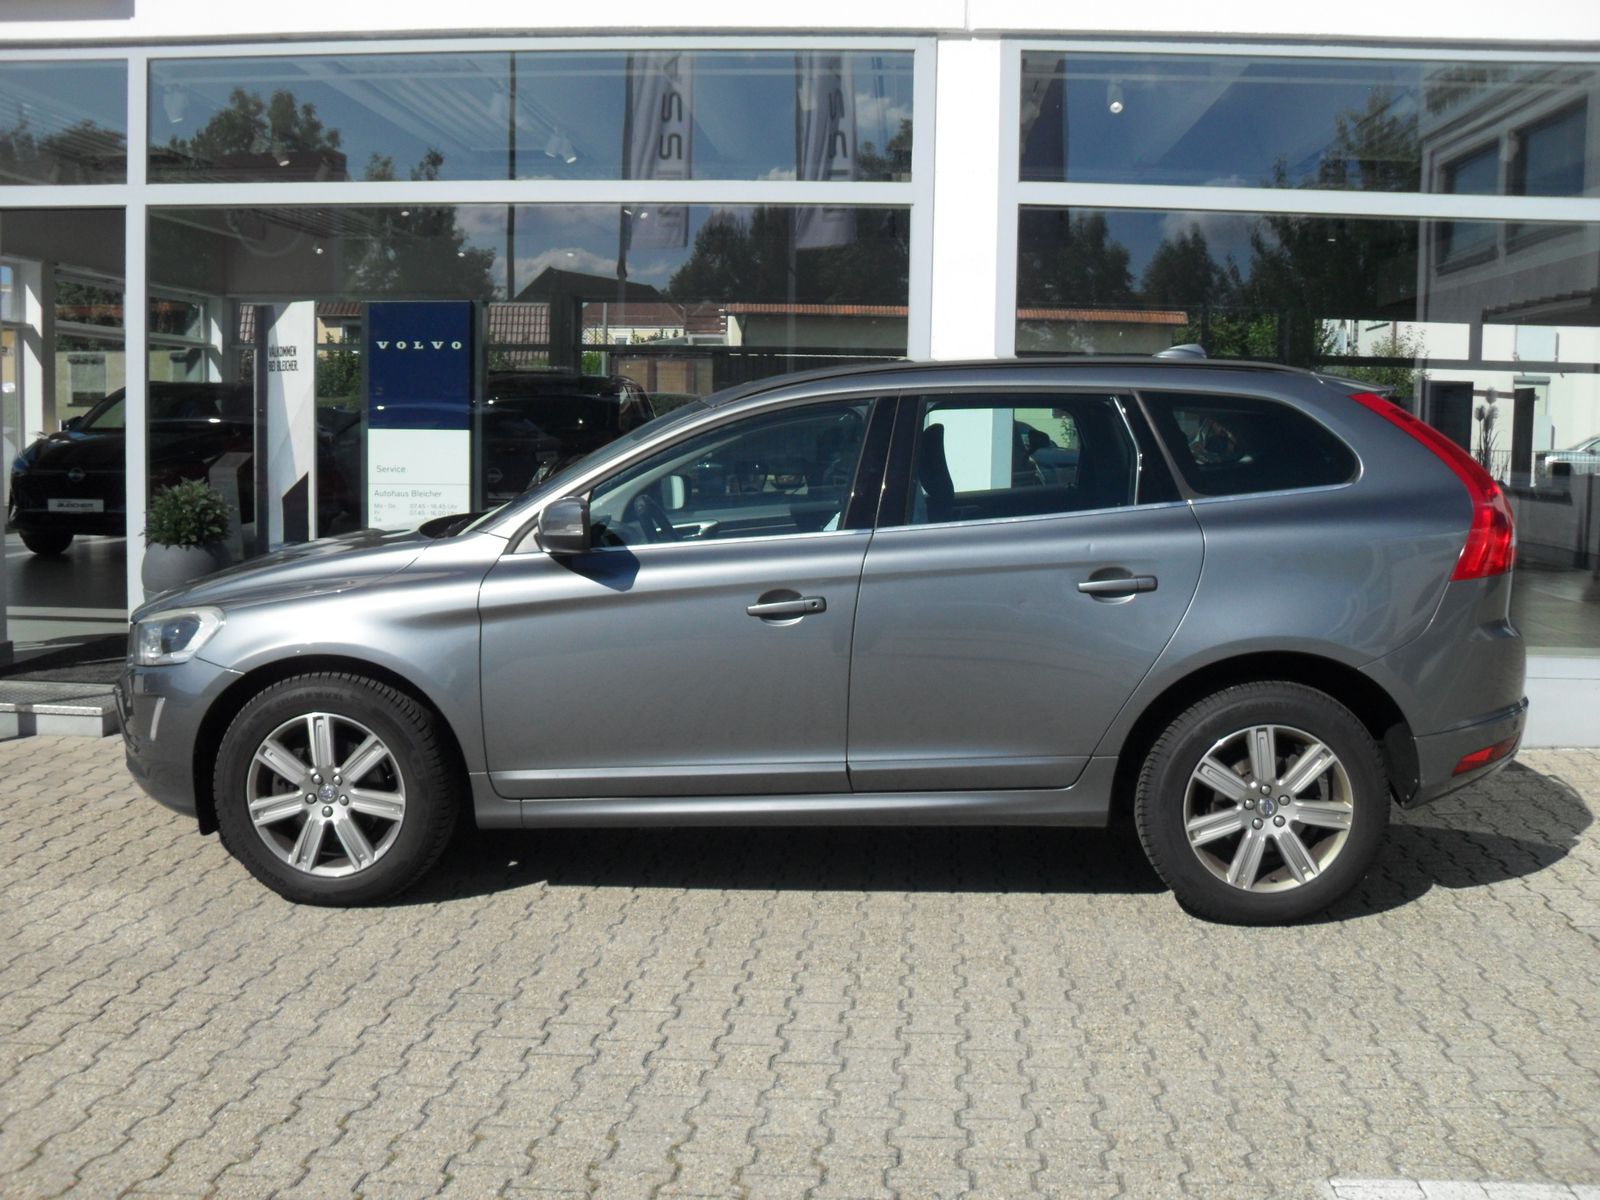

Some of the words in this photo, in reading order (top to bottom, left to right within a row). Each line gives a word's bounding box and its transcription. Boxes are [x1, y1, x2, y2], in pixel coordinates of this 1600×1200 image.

[376, 341, 462, 350] VOLVO
[376, 464, 406, 473] Service
[374, 489, 409, 497] Autohaus
[411, 489, 442, 497] Bleicher
